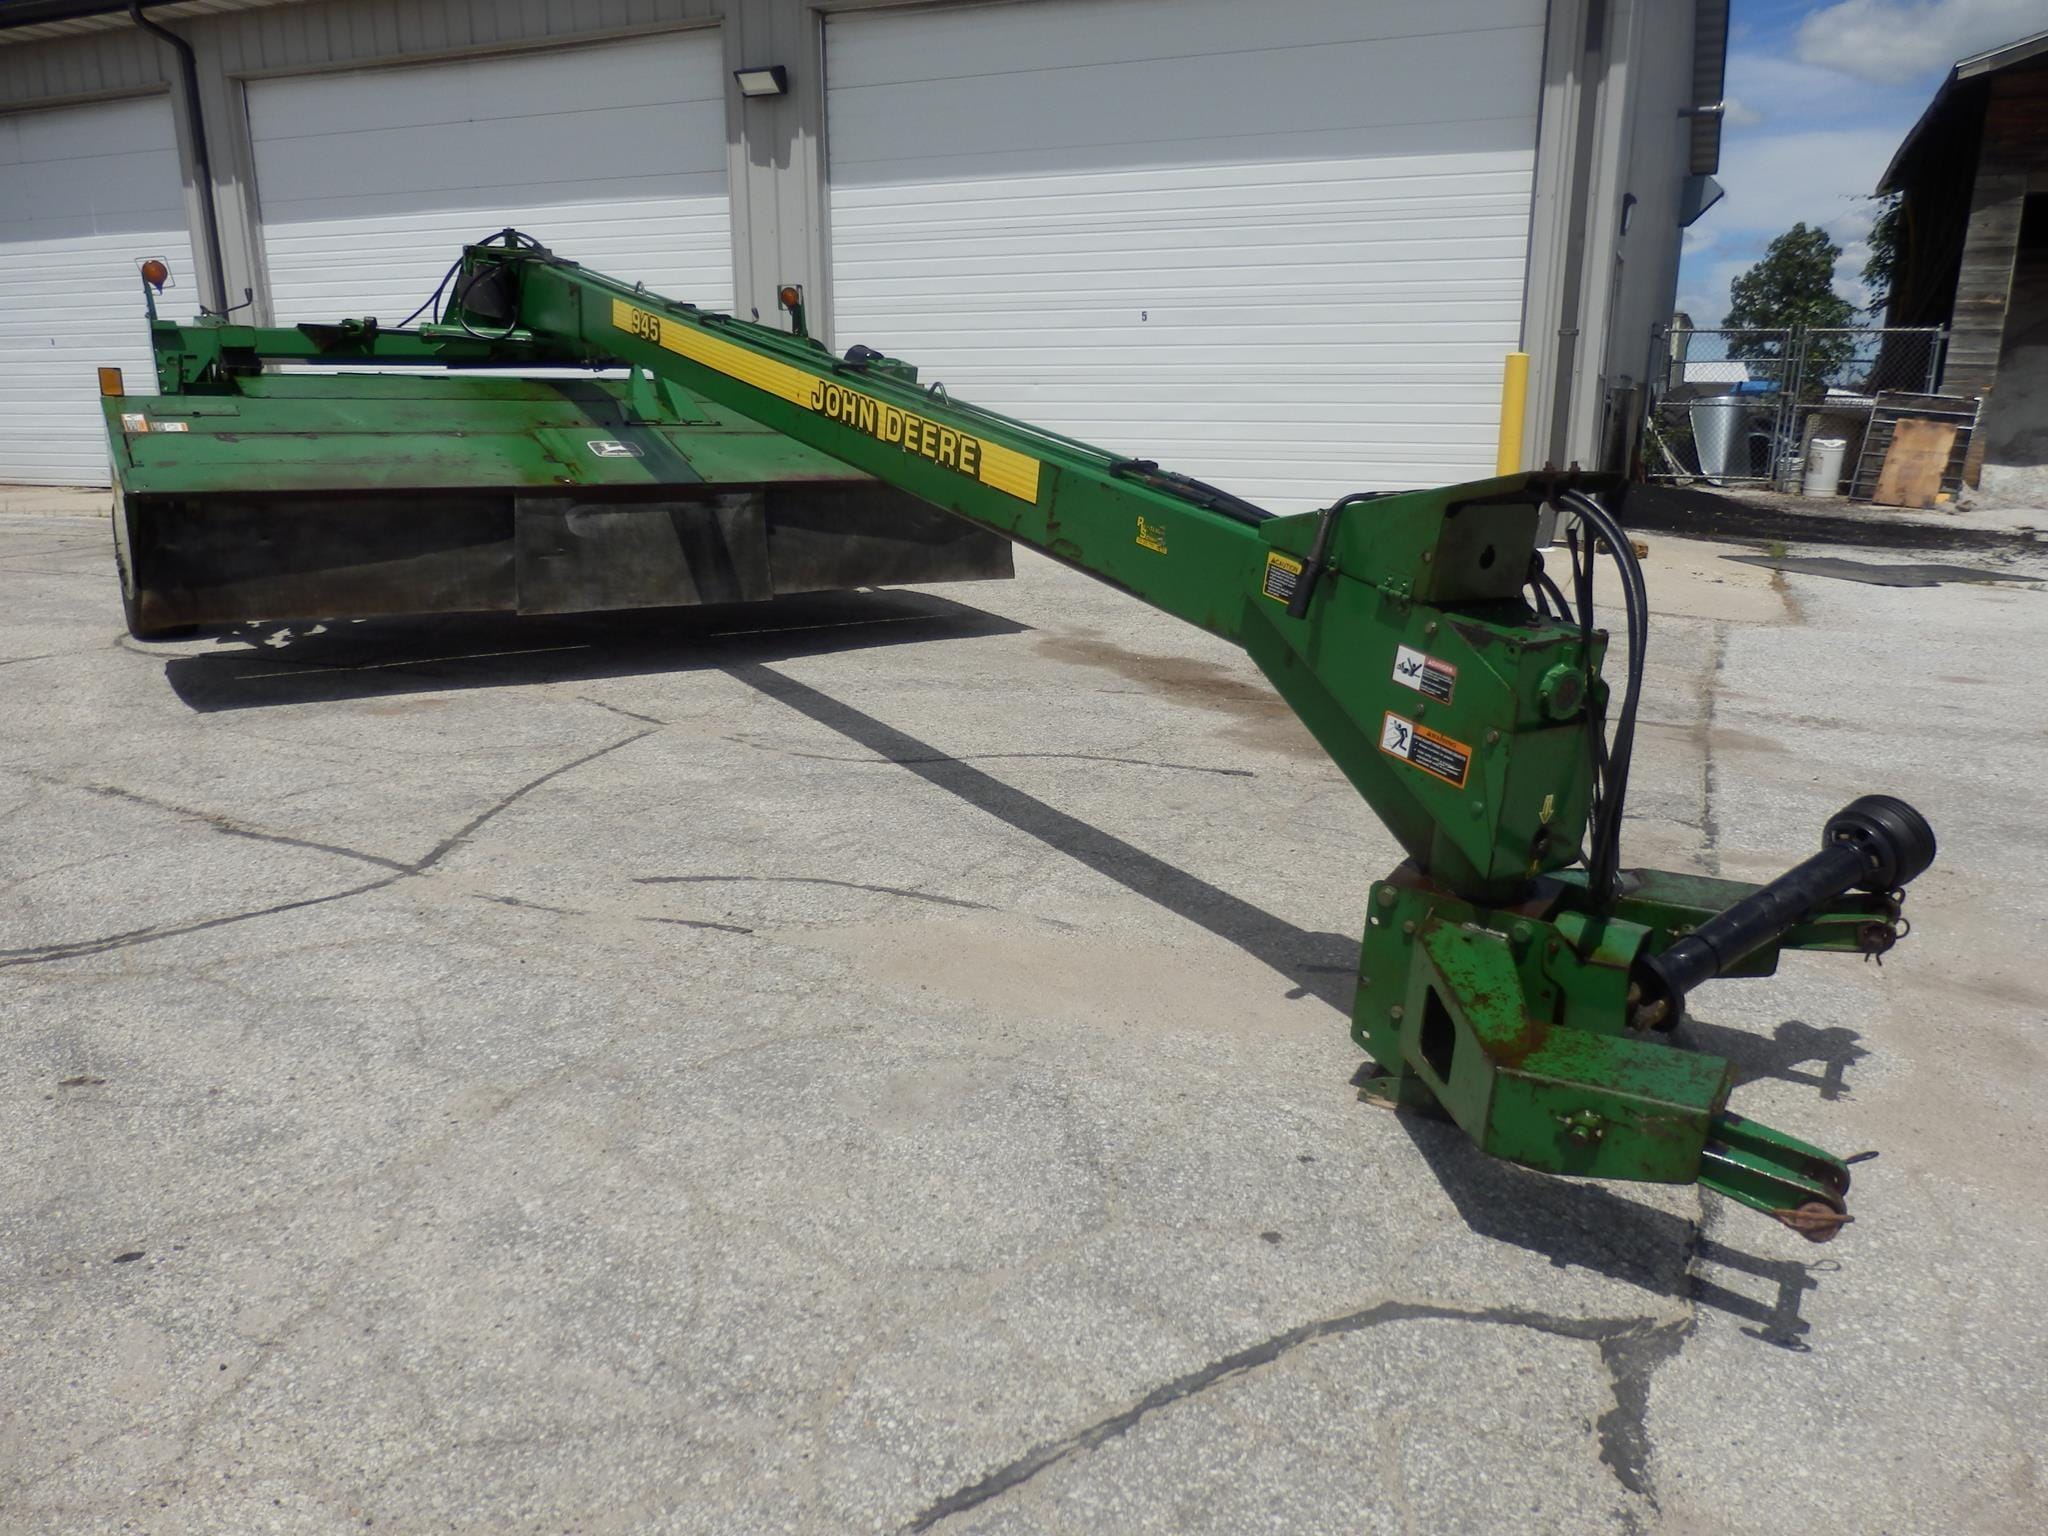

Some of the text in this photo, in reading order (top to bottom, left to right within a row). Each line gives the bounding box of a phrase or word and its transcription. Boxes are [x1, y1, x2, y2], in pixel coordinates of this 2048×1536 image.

[631, 308, 660, 342] 945
[1141, 311, 1147, 321] 5
[811, 381, 981, 478] JOHN DEERE
